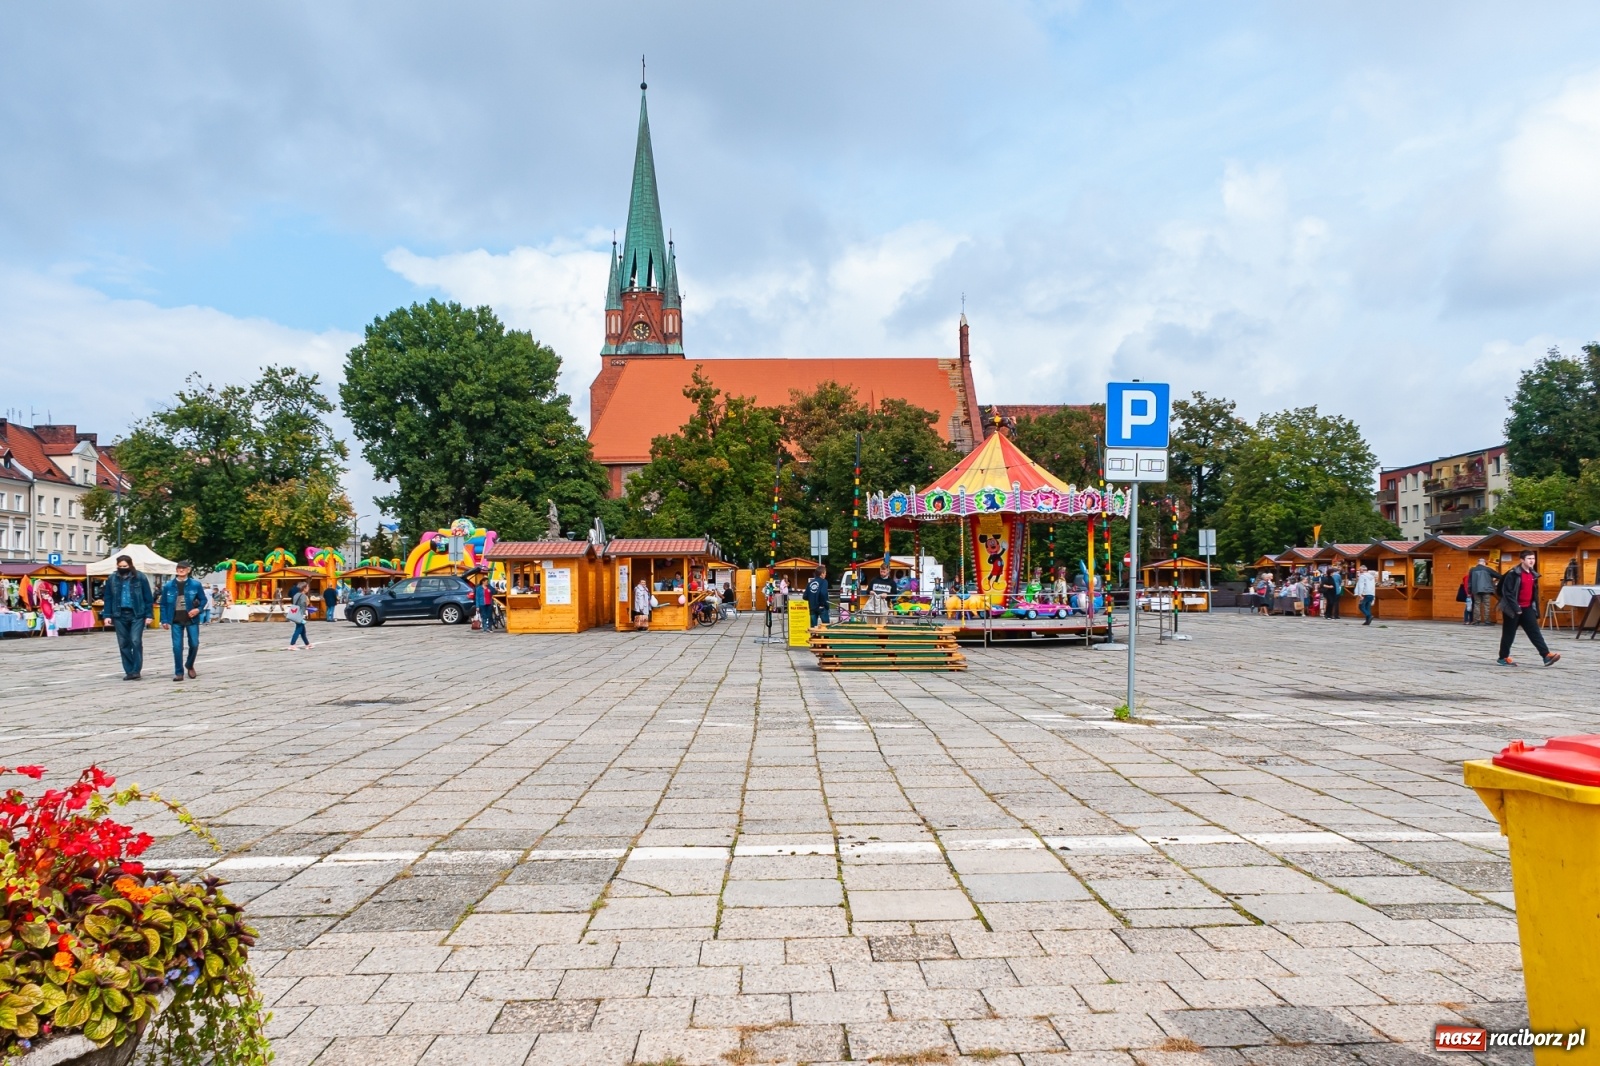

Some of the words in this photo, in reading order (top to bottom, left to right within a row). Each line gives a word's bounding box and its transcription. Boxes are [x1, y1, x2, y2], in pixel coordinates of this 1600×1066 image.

[1121, 389, 1157, 440] P
[1545, 513, 1552, 526] P
[51, 554, 59, 565] P
